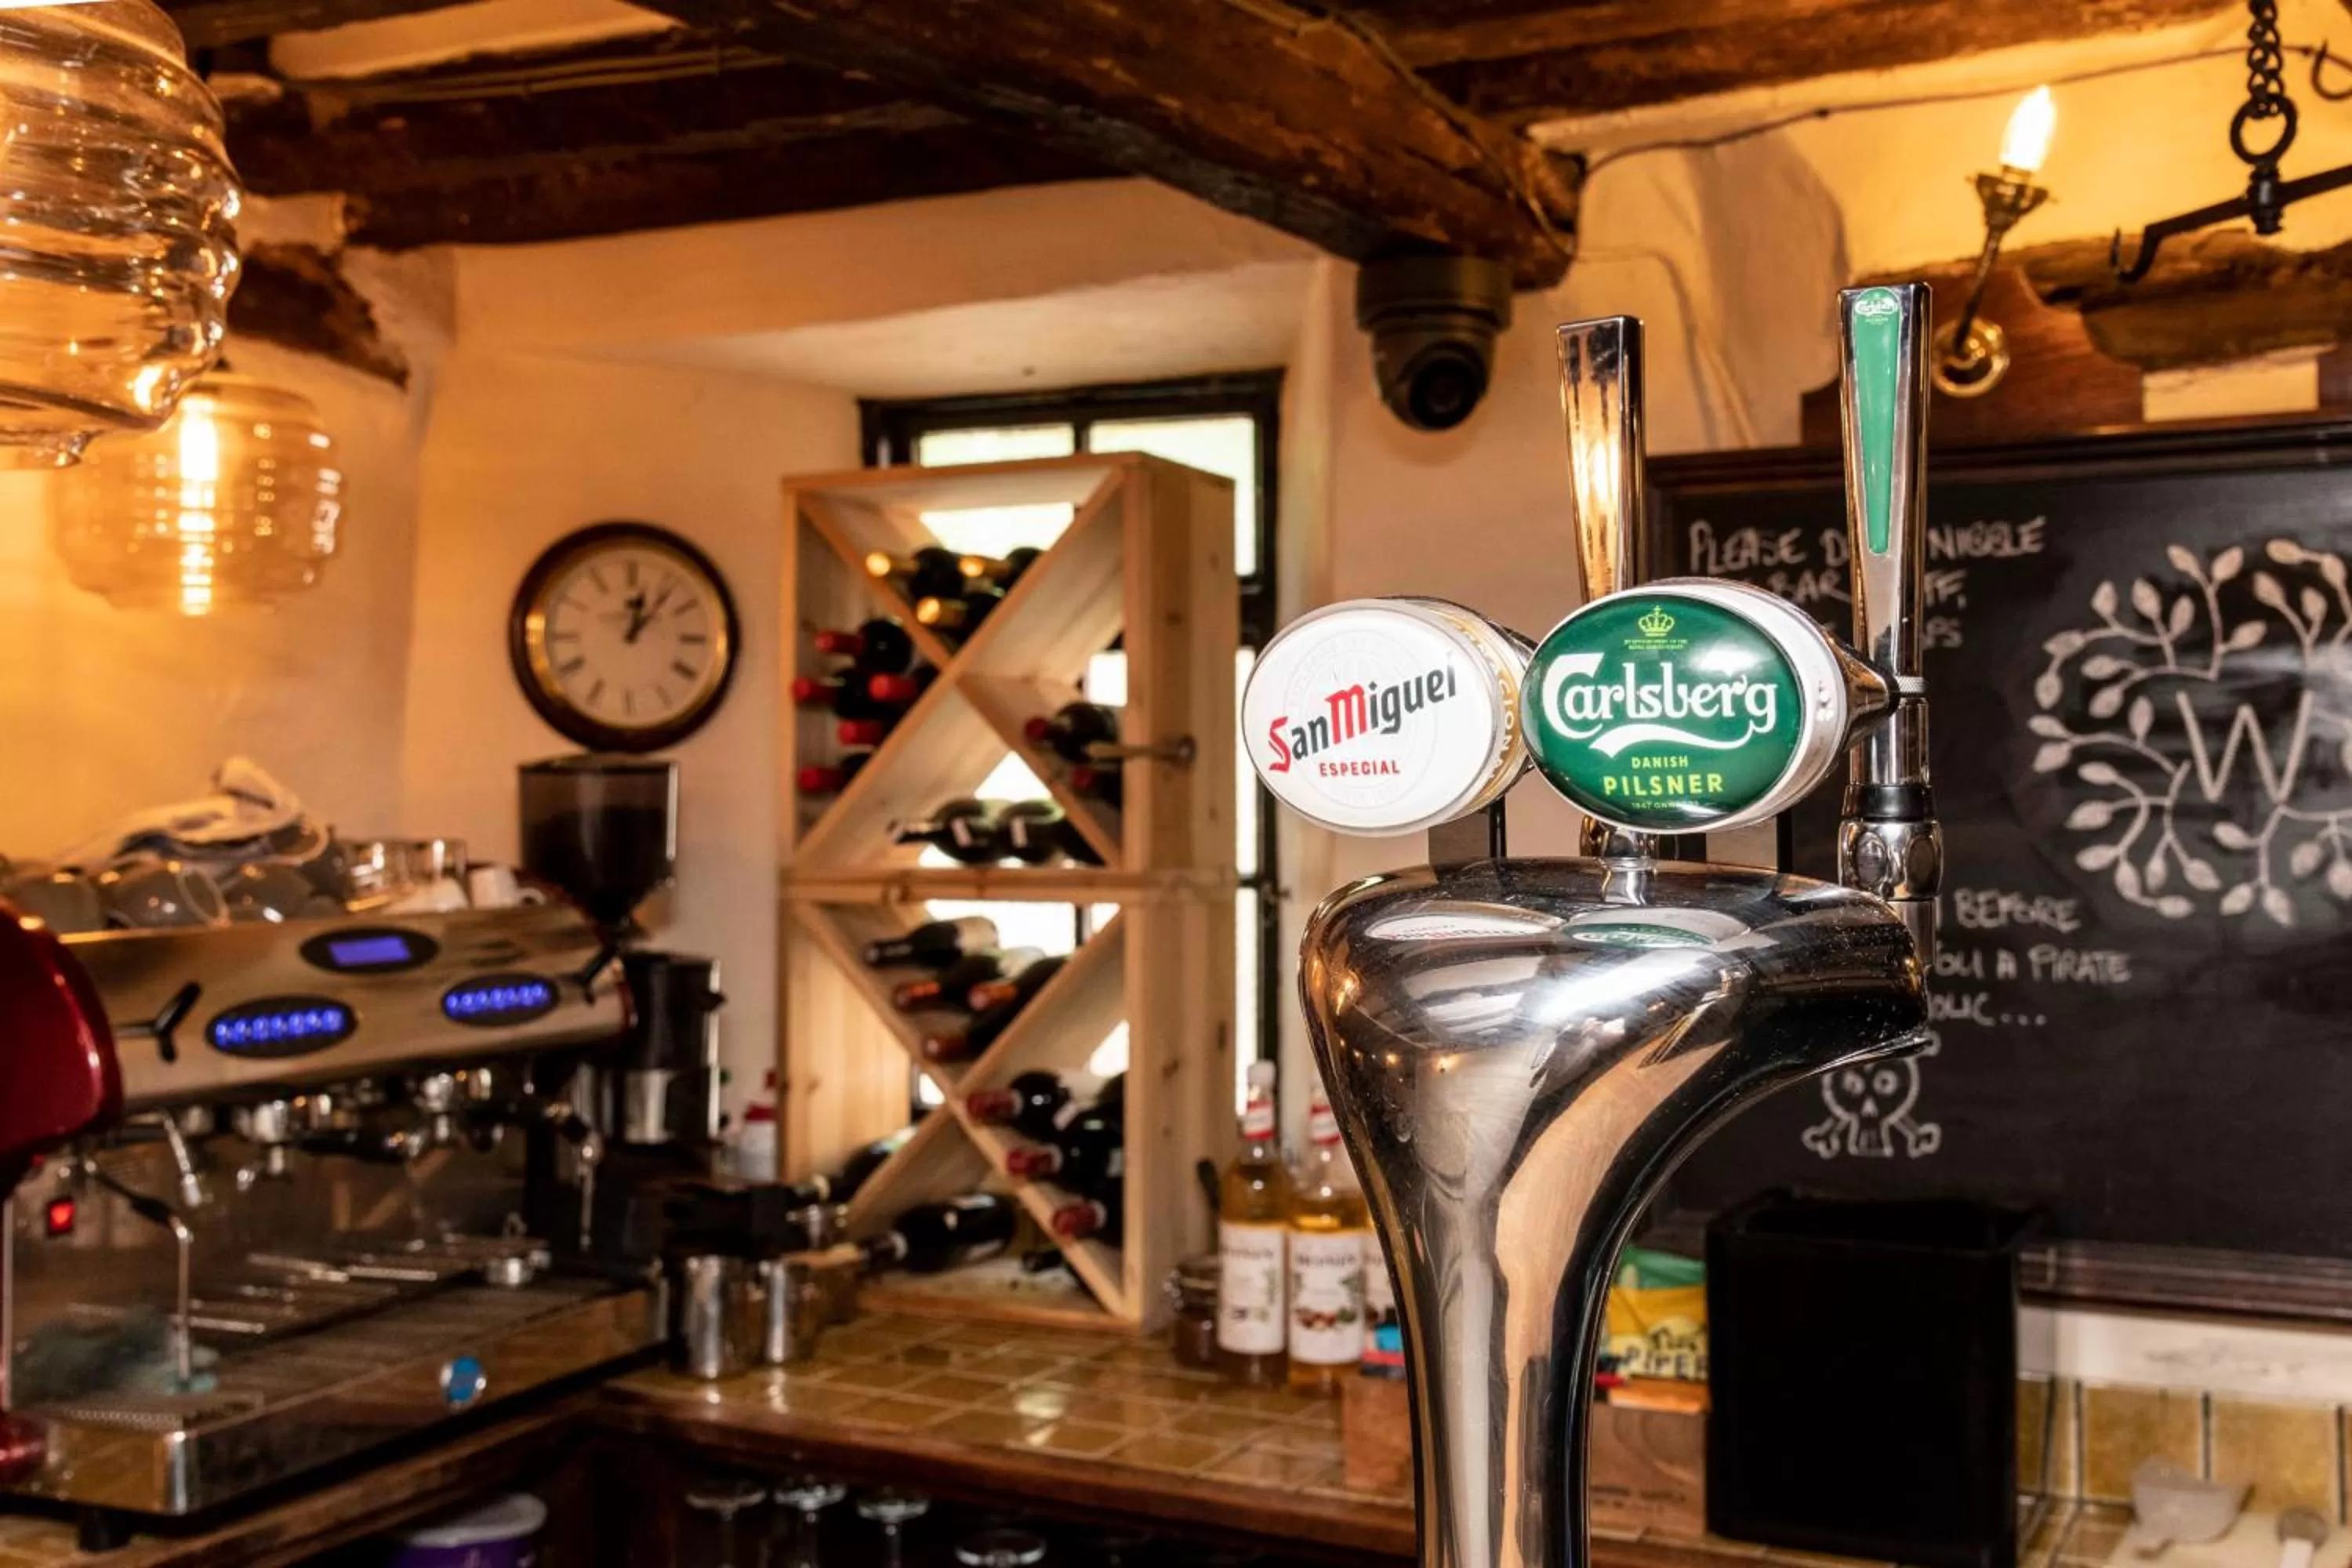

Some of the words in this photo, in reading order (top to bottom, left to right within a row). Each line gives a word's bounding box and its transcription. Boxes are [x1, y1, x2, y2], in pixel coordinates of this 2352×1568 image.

[1689, 519, 1807, 575] PLEASE
[1541, 652, 1779, 740] Carlsberg
[1319, 759, 1401, 778] ESPECIAL
[1631, 755, 1689, 769] DANISH
[1602, 772, 1725, 797] PILSNER
[1934, 940, 1985, 980] OU
[1995, 947, 2018, 980] A
[2027, 942, 2134, 985] PIRATE
